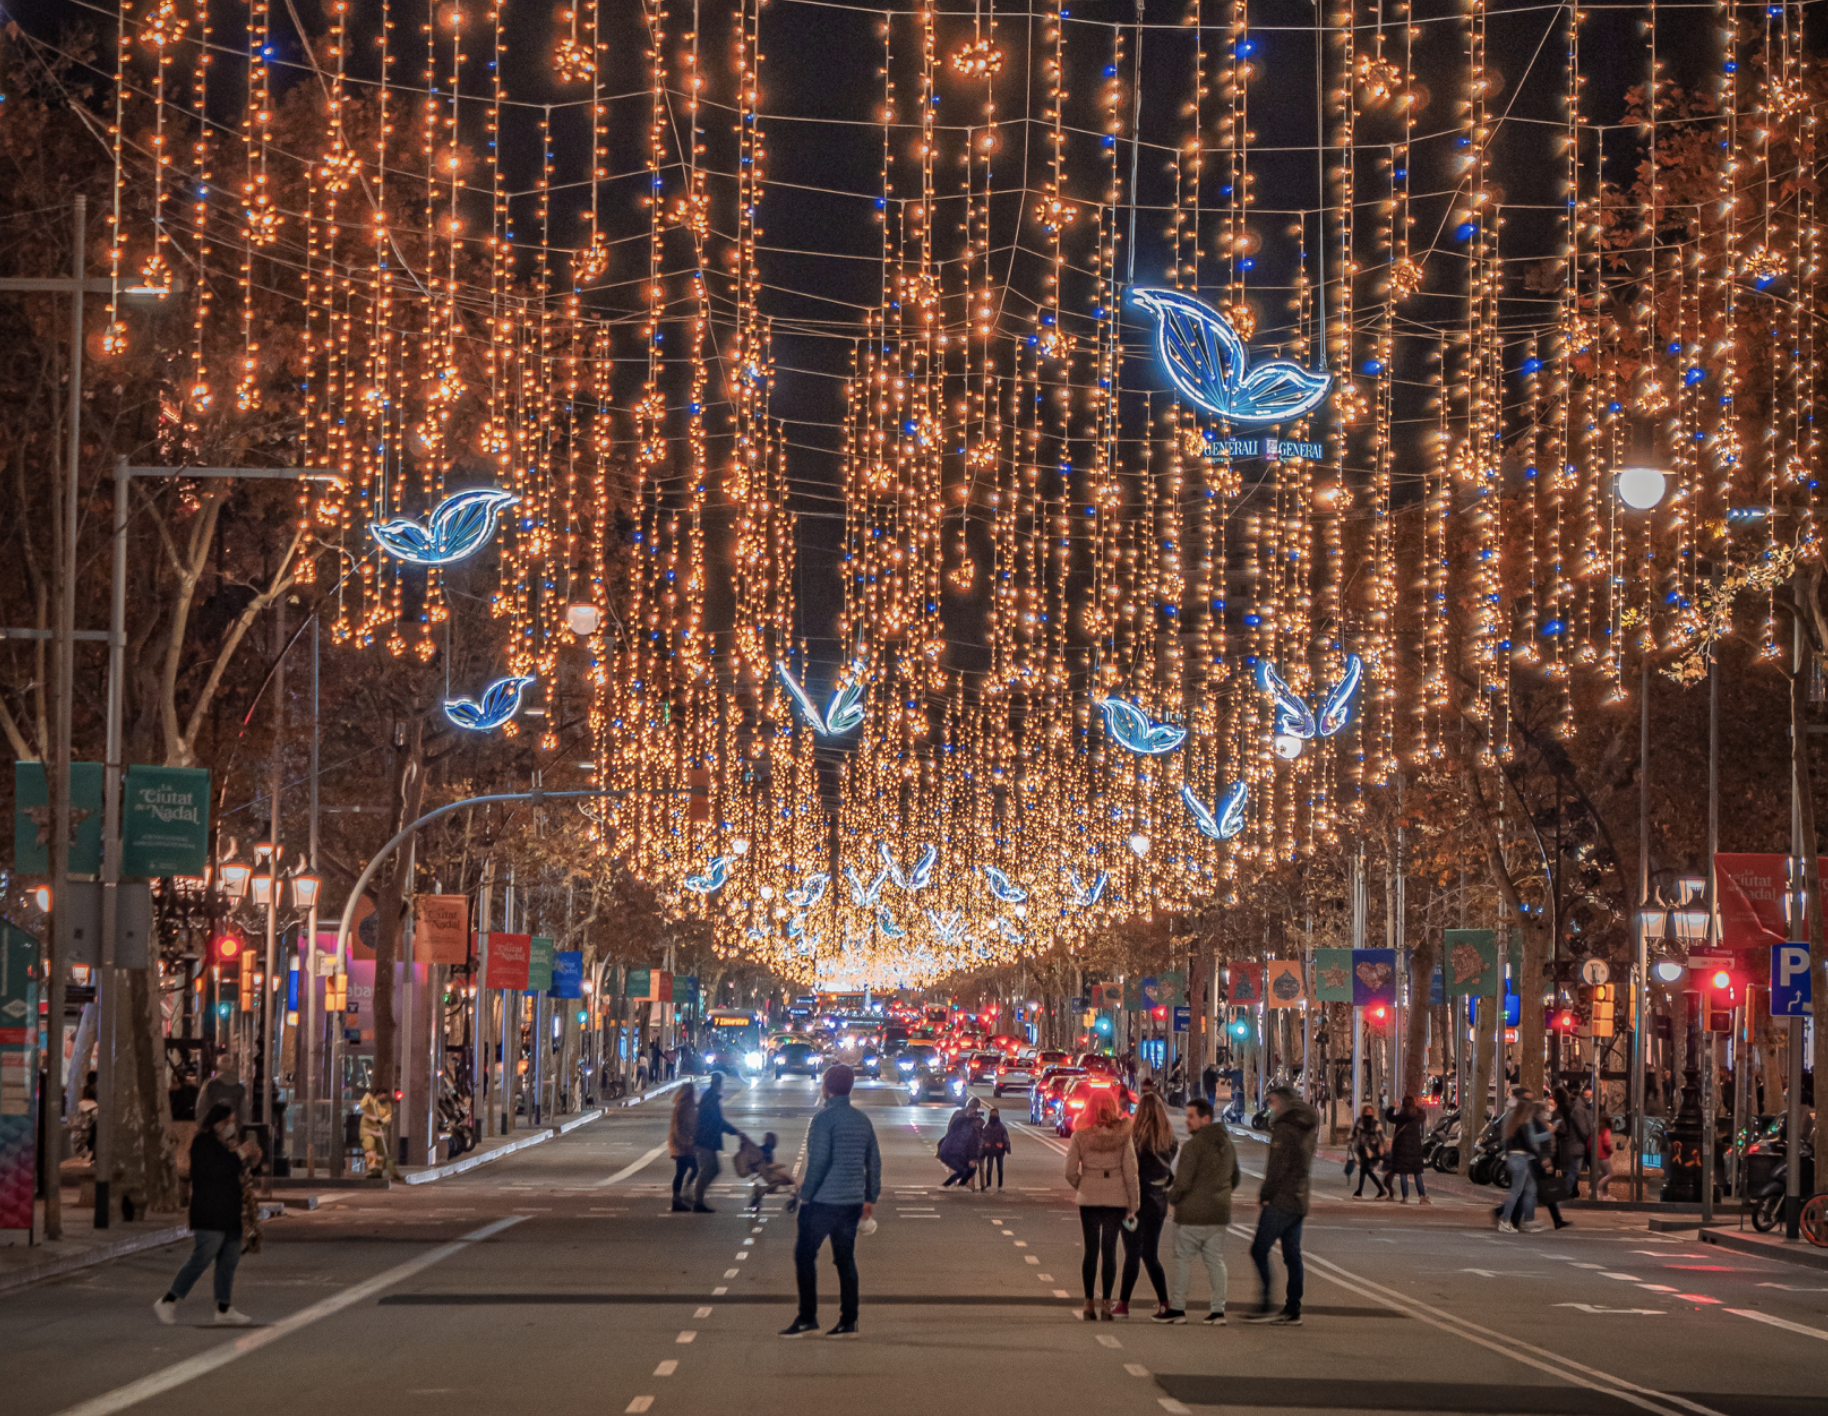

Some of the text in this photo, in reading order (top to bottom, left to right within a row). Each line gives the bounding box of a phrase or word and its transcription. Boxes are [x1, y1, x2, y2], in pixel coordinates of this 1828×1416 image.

[1203, 440, 1259, 456] GENERALI
[139, 789, 193, 805] Ciutat
[147, 804, 200, 825] Nadal
[1780, 947, 1810, 987] P
